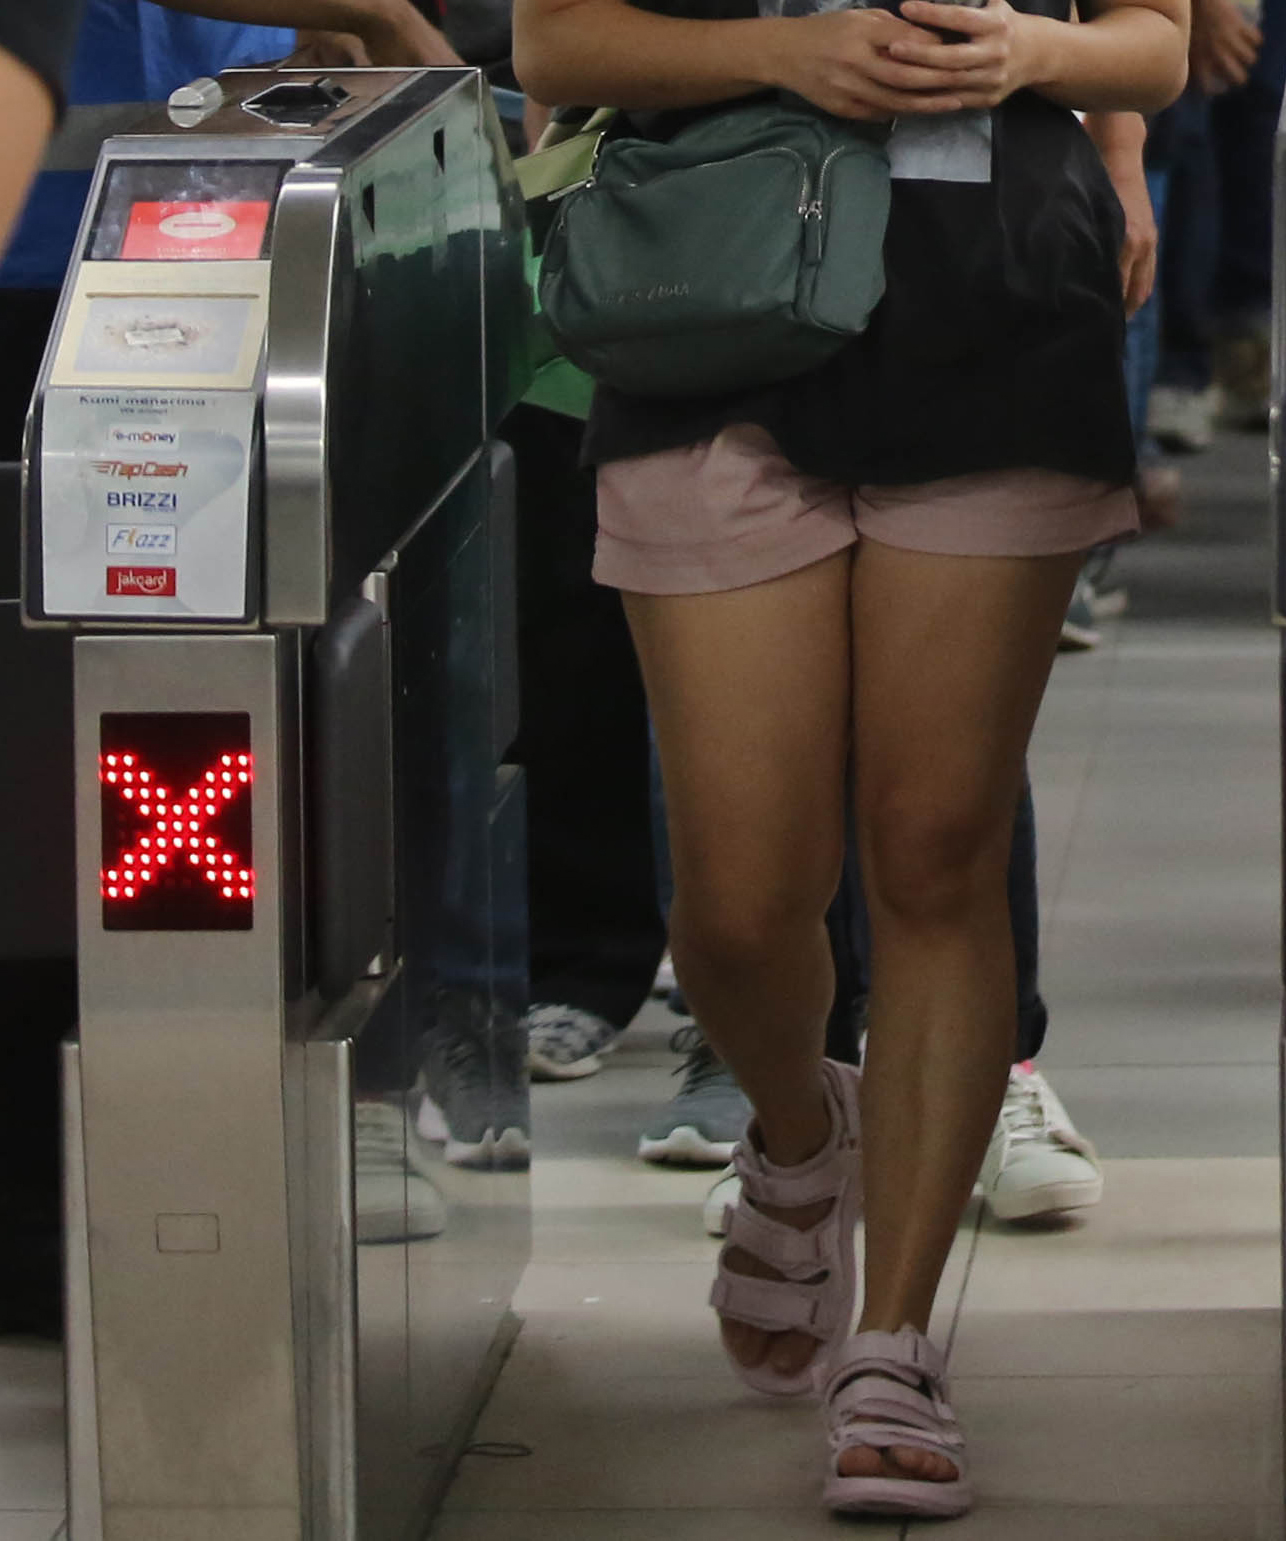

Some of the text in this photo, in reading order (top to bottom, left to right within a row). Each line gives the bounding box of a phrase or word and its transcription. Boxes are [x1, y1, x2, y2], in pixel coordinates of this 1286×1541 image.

[115, 431, 176, 444] e-money
[106, 461, 189, 480] TapCash
[107, 491, 177, 508] BRIZZI
[111, 527, 171, 548] Flazz
[116, 571, 167, 593] jakcard
